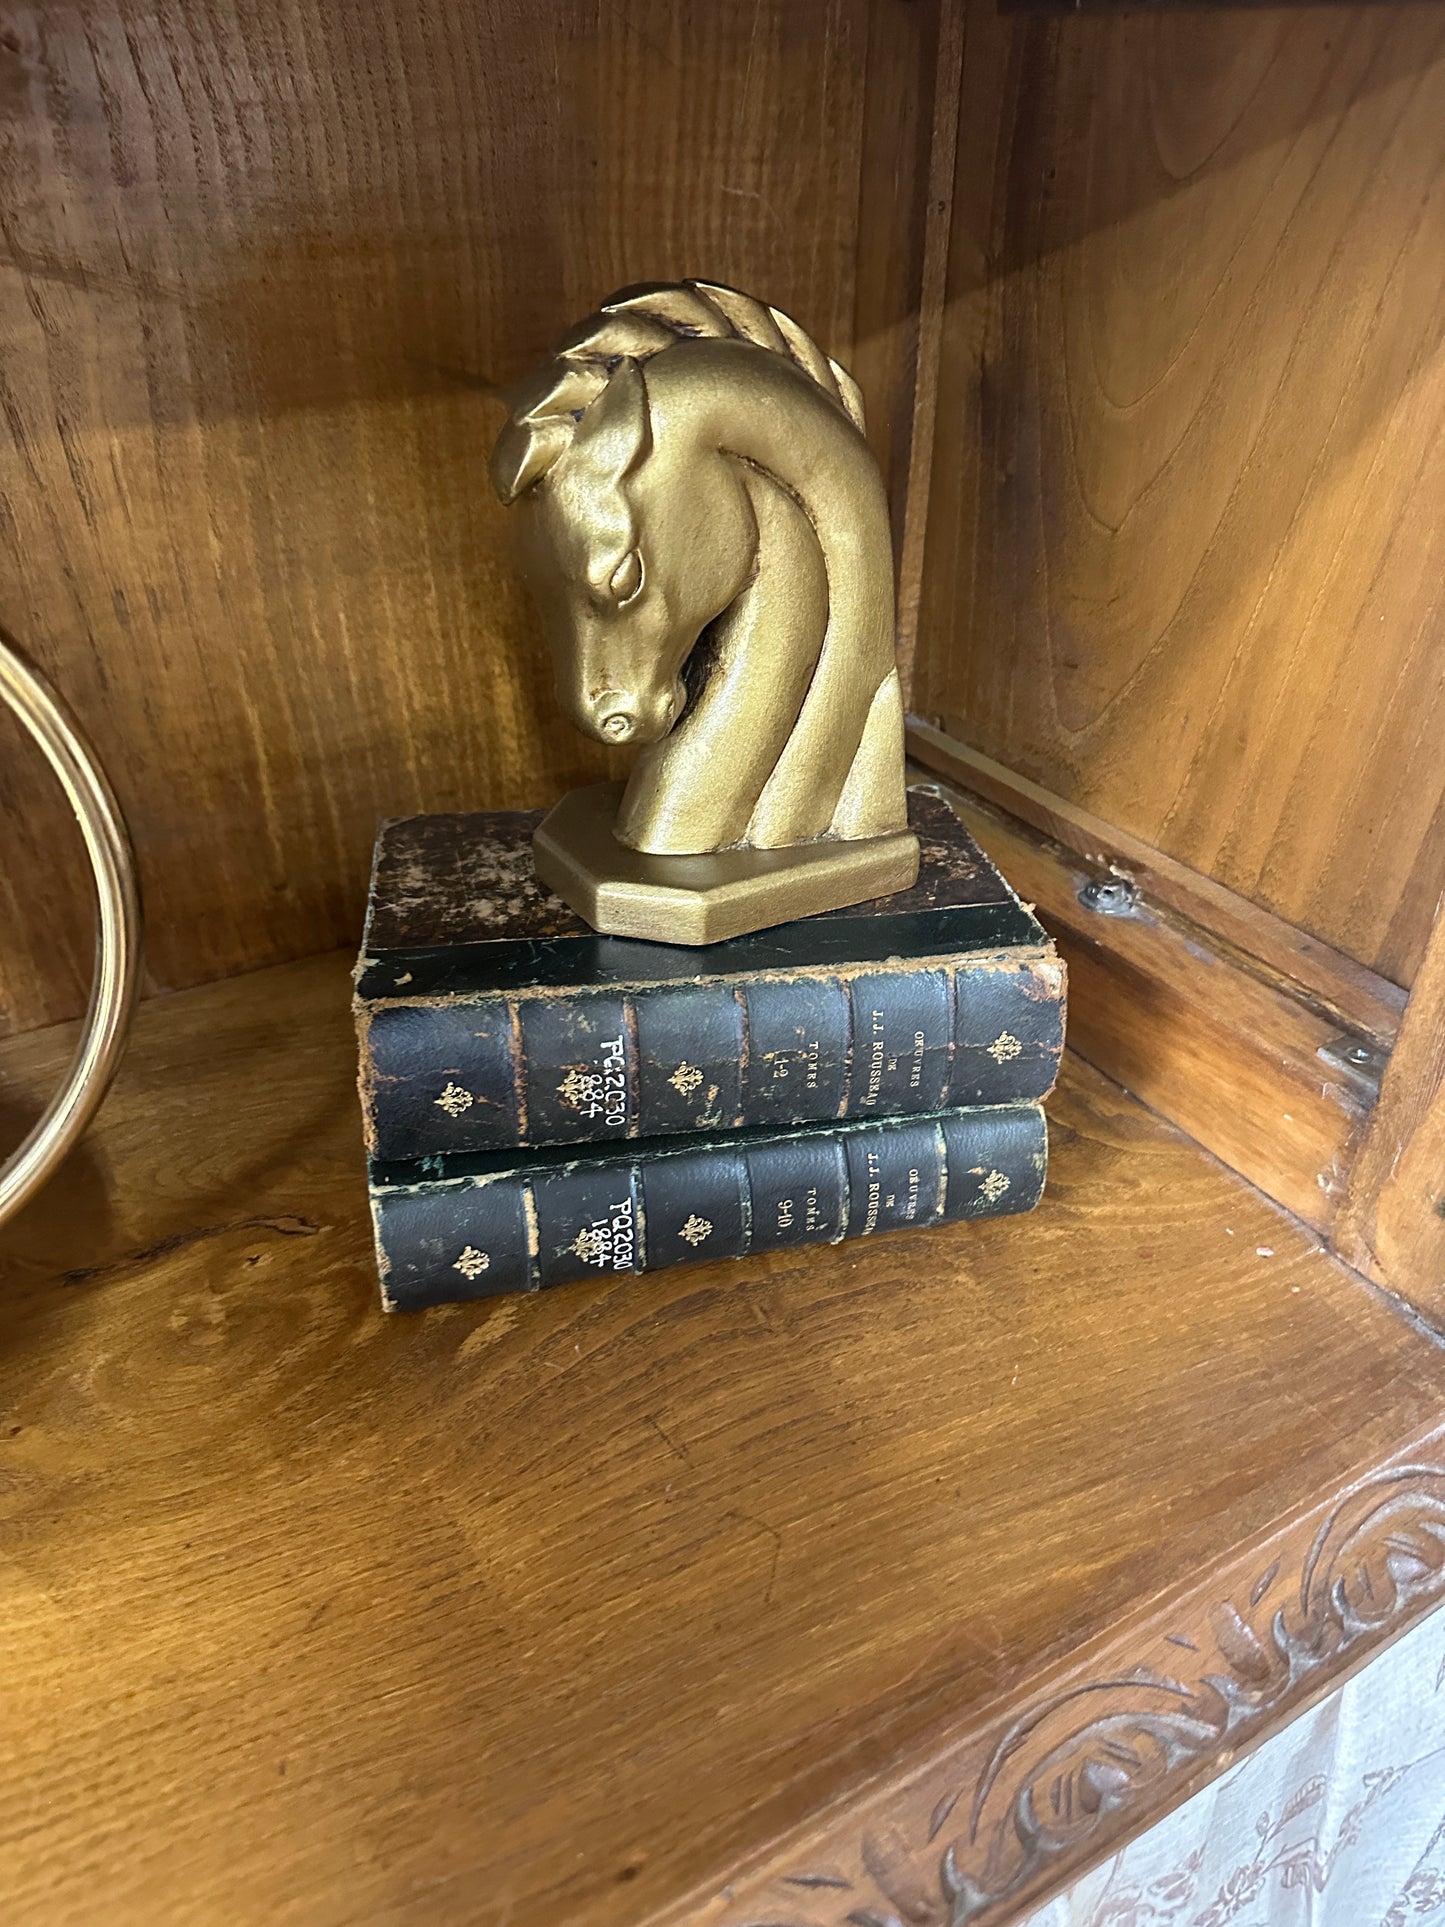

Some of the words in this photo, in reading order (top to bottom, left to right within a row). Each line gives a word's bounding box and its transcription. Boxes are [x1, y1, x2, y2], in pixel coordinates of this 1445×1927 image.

[773, 1057, 790, 1078] 1-2
[806, 1041, 819, 1089] TOMES
[866, 1041, 884, 1106] ROUSSEAU
[580, 1060, 604, 1119] 884
[609, 1197, 634, 1270] PQ2030
[777, 1199, 794, 1228] 9-10
[805, 1187, 817, 1232] TOMES
[590, 1218, 612, 1267] 1884
